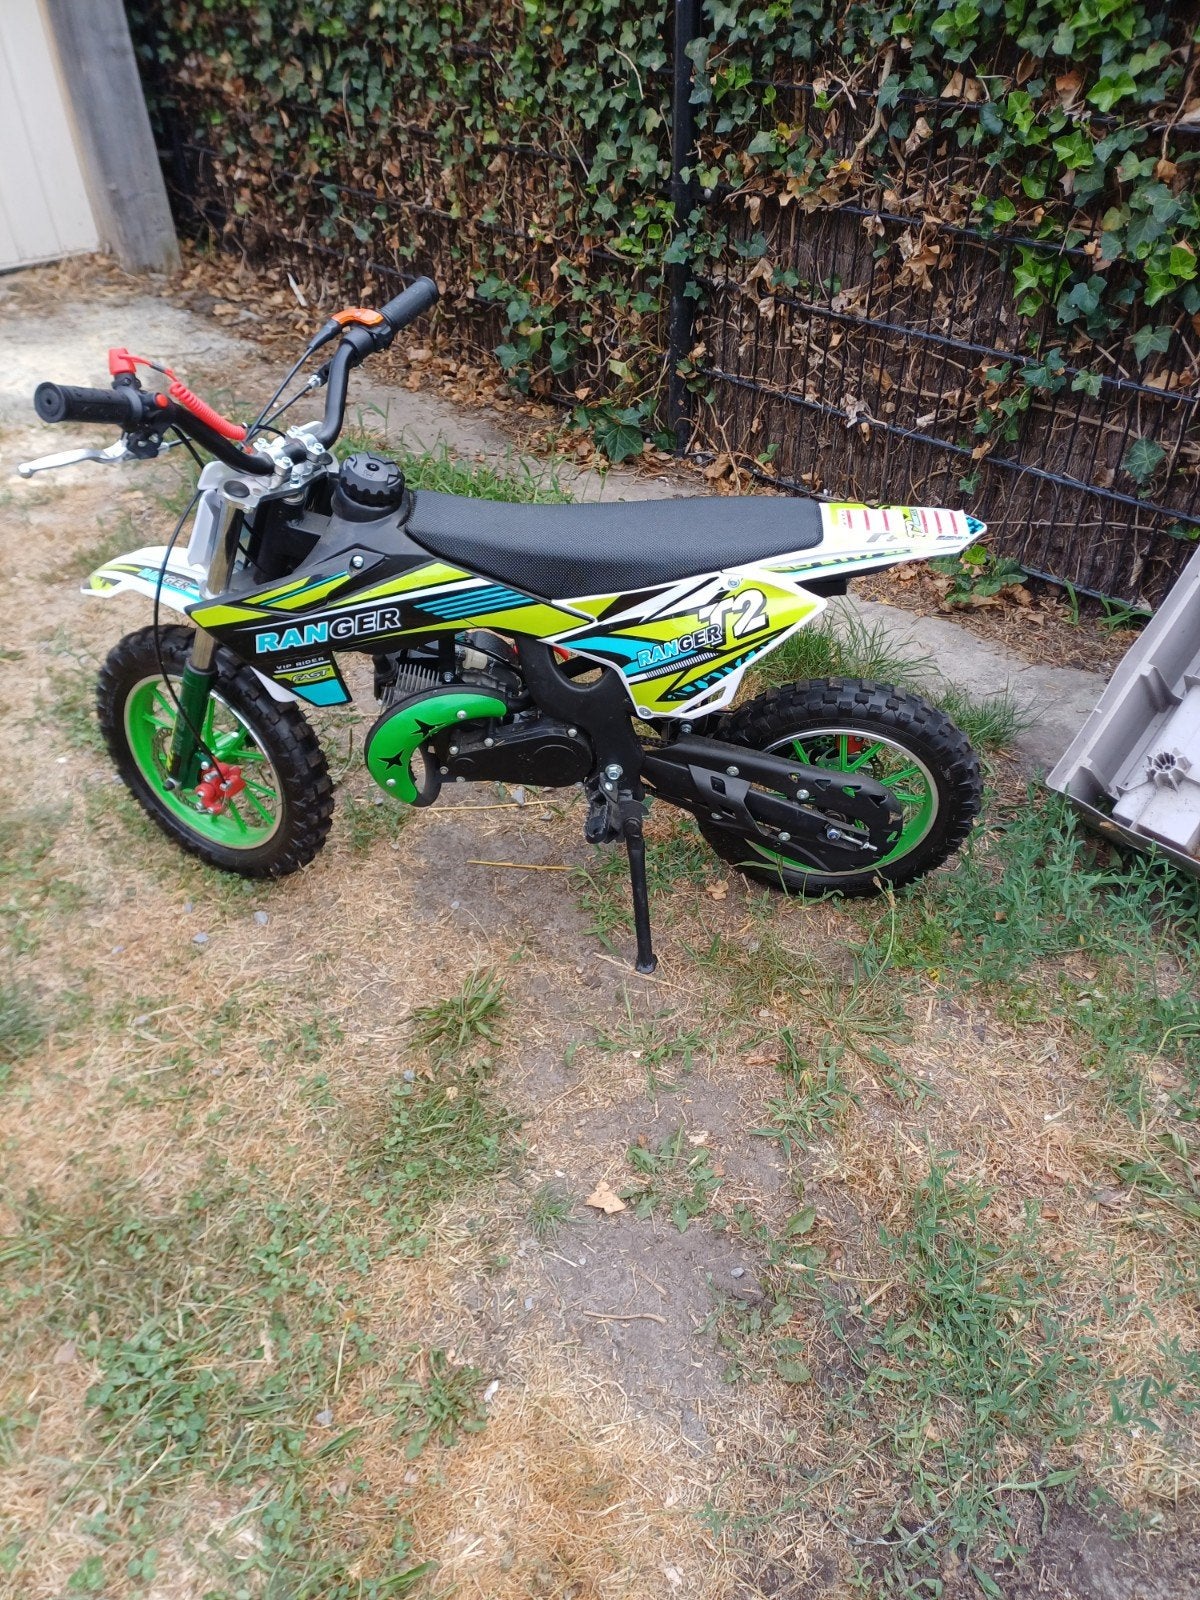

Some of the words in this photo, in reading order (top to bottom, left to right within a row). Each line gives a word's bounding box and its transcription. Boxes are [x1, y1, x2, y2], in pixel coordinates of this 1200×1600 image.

[255, 607, 402, 654] RANGER
[637, 624, 723, 668] RANGER
[292, 668, 328, 682] FAST
[295, 656, 325, 667] RIDER
